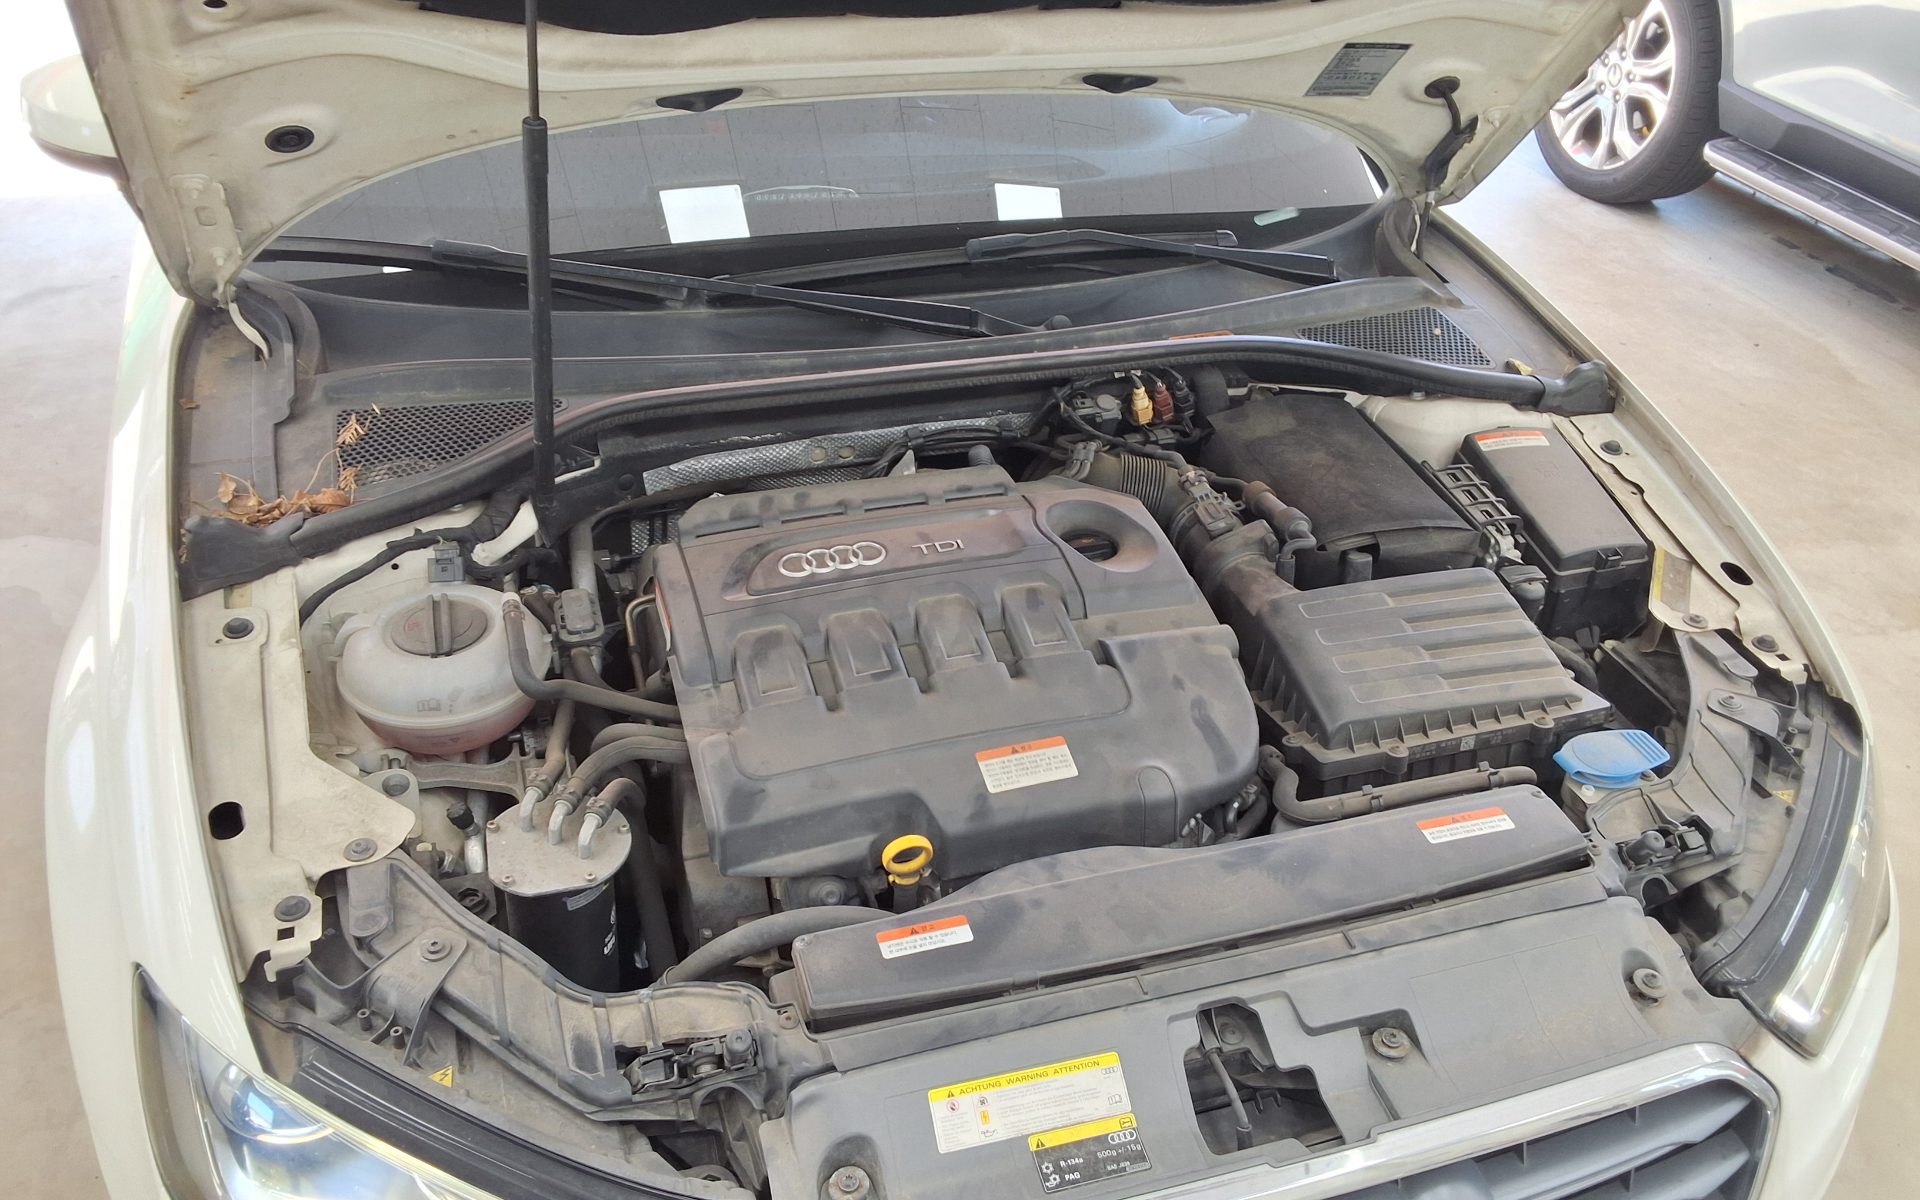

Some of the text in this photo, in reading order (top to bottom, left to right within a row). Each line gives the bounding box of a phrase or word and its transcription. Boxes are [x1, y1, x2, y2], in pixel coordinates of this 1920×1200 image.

[912, 540, 964, 554] TDI
[959, 1060, 1100, 1095] ACHTUNG WARNING ATTENTION
[1060, 1157, 1083, 1168] R-134a
[1065, 1172, 1080, 1181] PAG
